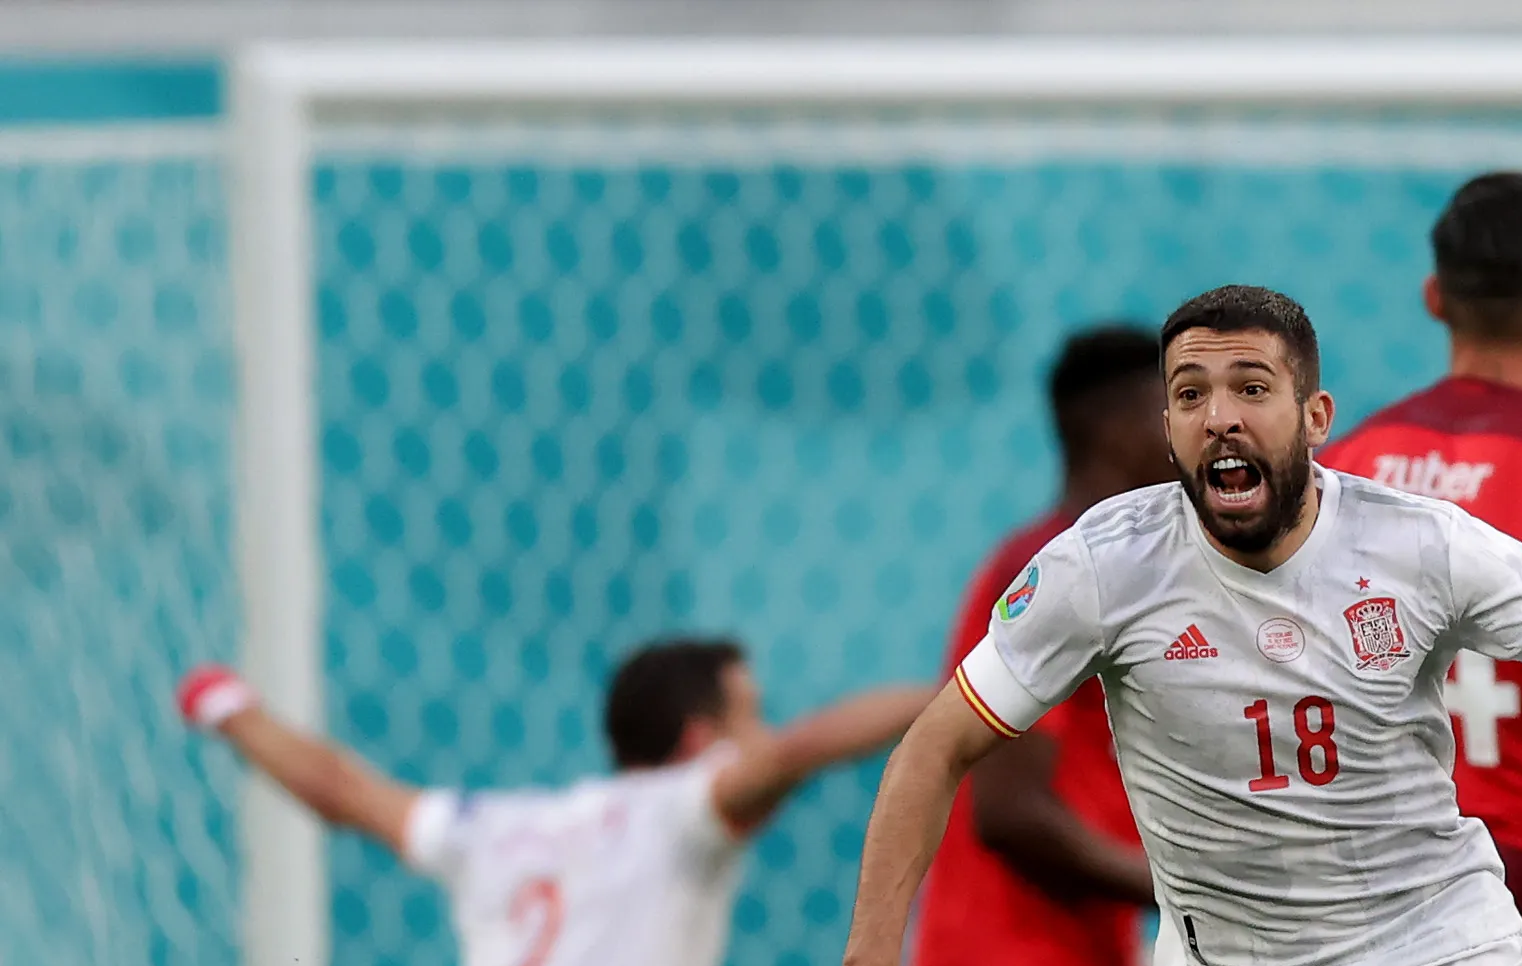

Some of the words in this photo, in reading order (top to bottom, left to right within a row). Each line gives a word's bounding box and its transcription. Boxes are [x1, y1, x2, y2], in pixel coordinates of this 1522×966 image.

[1373, 449, 1496, 503] zuber
[1164, 646, 1219, 661] adidas
[1243, 694, 1341, 793] 18
